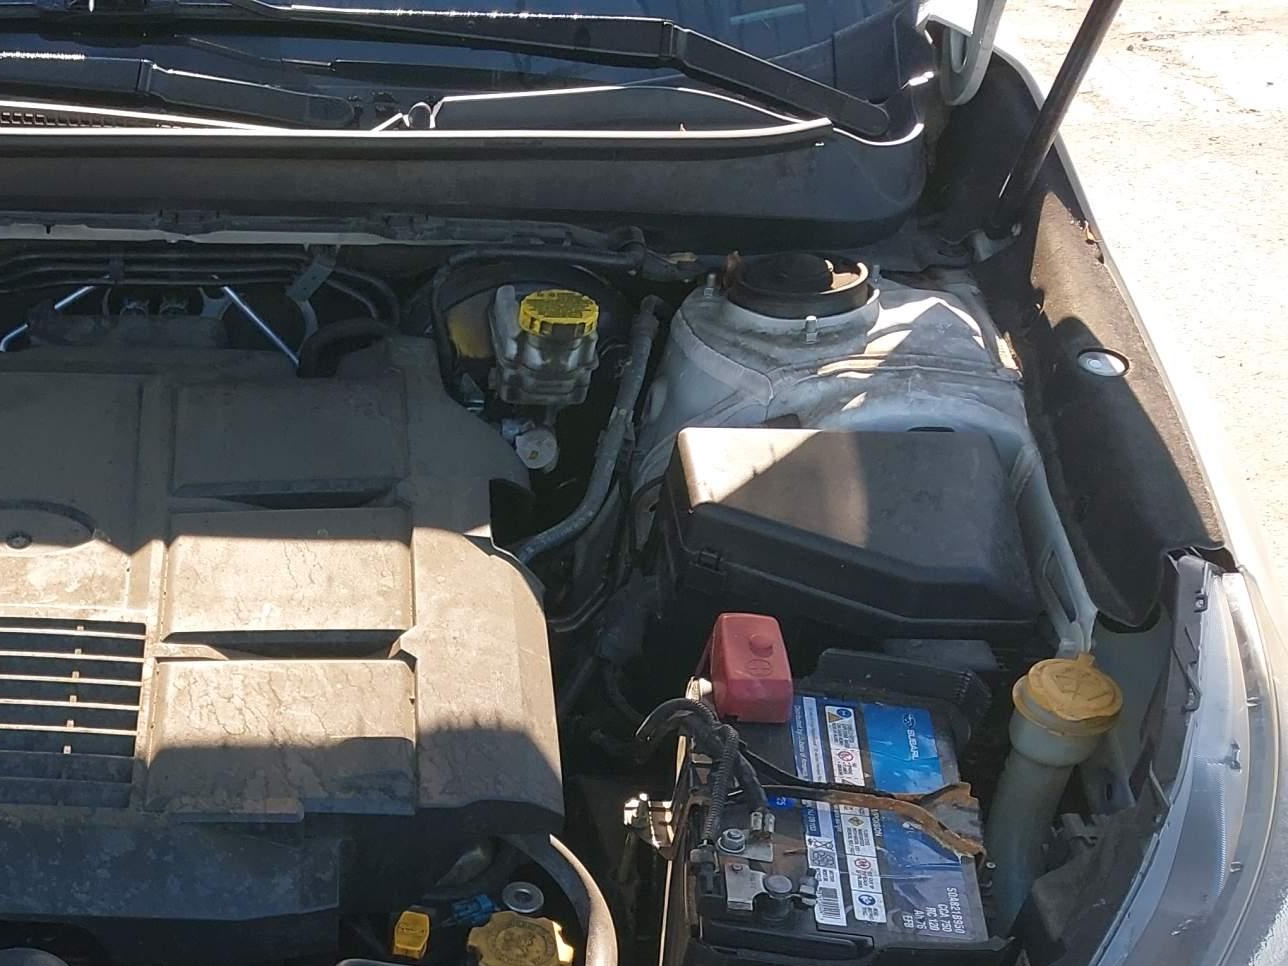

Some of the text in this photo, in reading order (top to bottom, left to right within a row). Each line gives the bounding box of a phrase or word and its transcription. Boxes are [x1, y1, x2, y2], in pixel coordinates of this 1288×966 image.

[902, 915, 914, 928] EFB
[913, 909, 927, 930] Ah 76
[928, 919, 940, 931] 120
[938, 904, 953, 933] CCA 750
